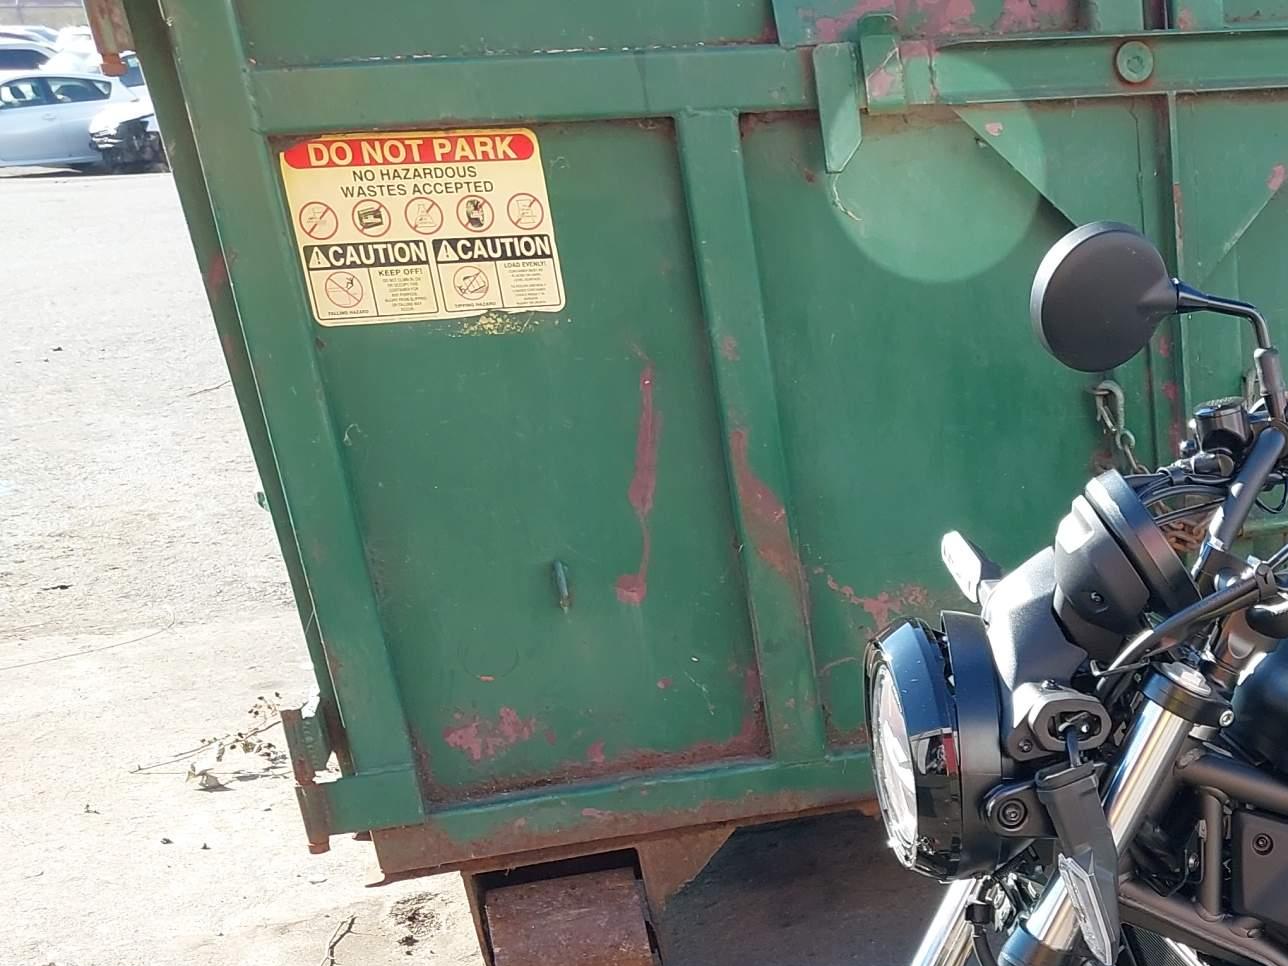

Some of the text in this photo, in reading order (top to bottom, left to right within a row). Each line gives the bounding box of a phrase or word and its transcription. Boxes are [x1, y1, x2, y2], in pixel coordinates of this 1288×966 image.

[307, 136, 518, 167] DO NOT PARK
[352, 165, 478, 183] NO HAZARDOUS
[340, 180, 494, 199] WASTES ACCEPTED
[327, 241, 427, 267] CAUTION
[456, 235, 551, 260] CAUTION
[378, 267, 423, 277] KEEP OFF!
[503, 261, 520, 269] LOAD
